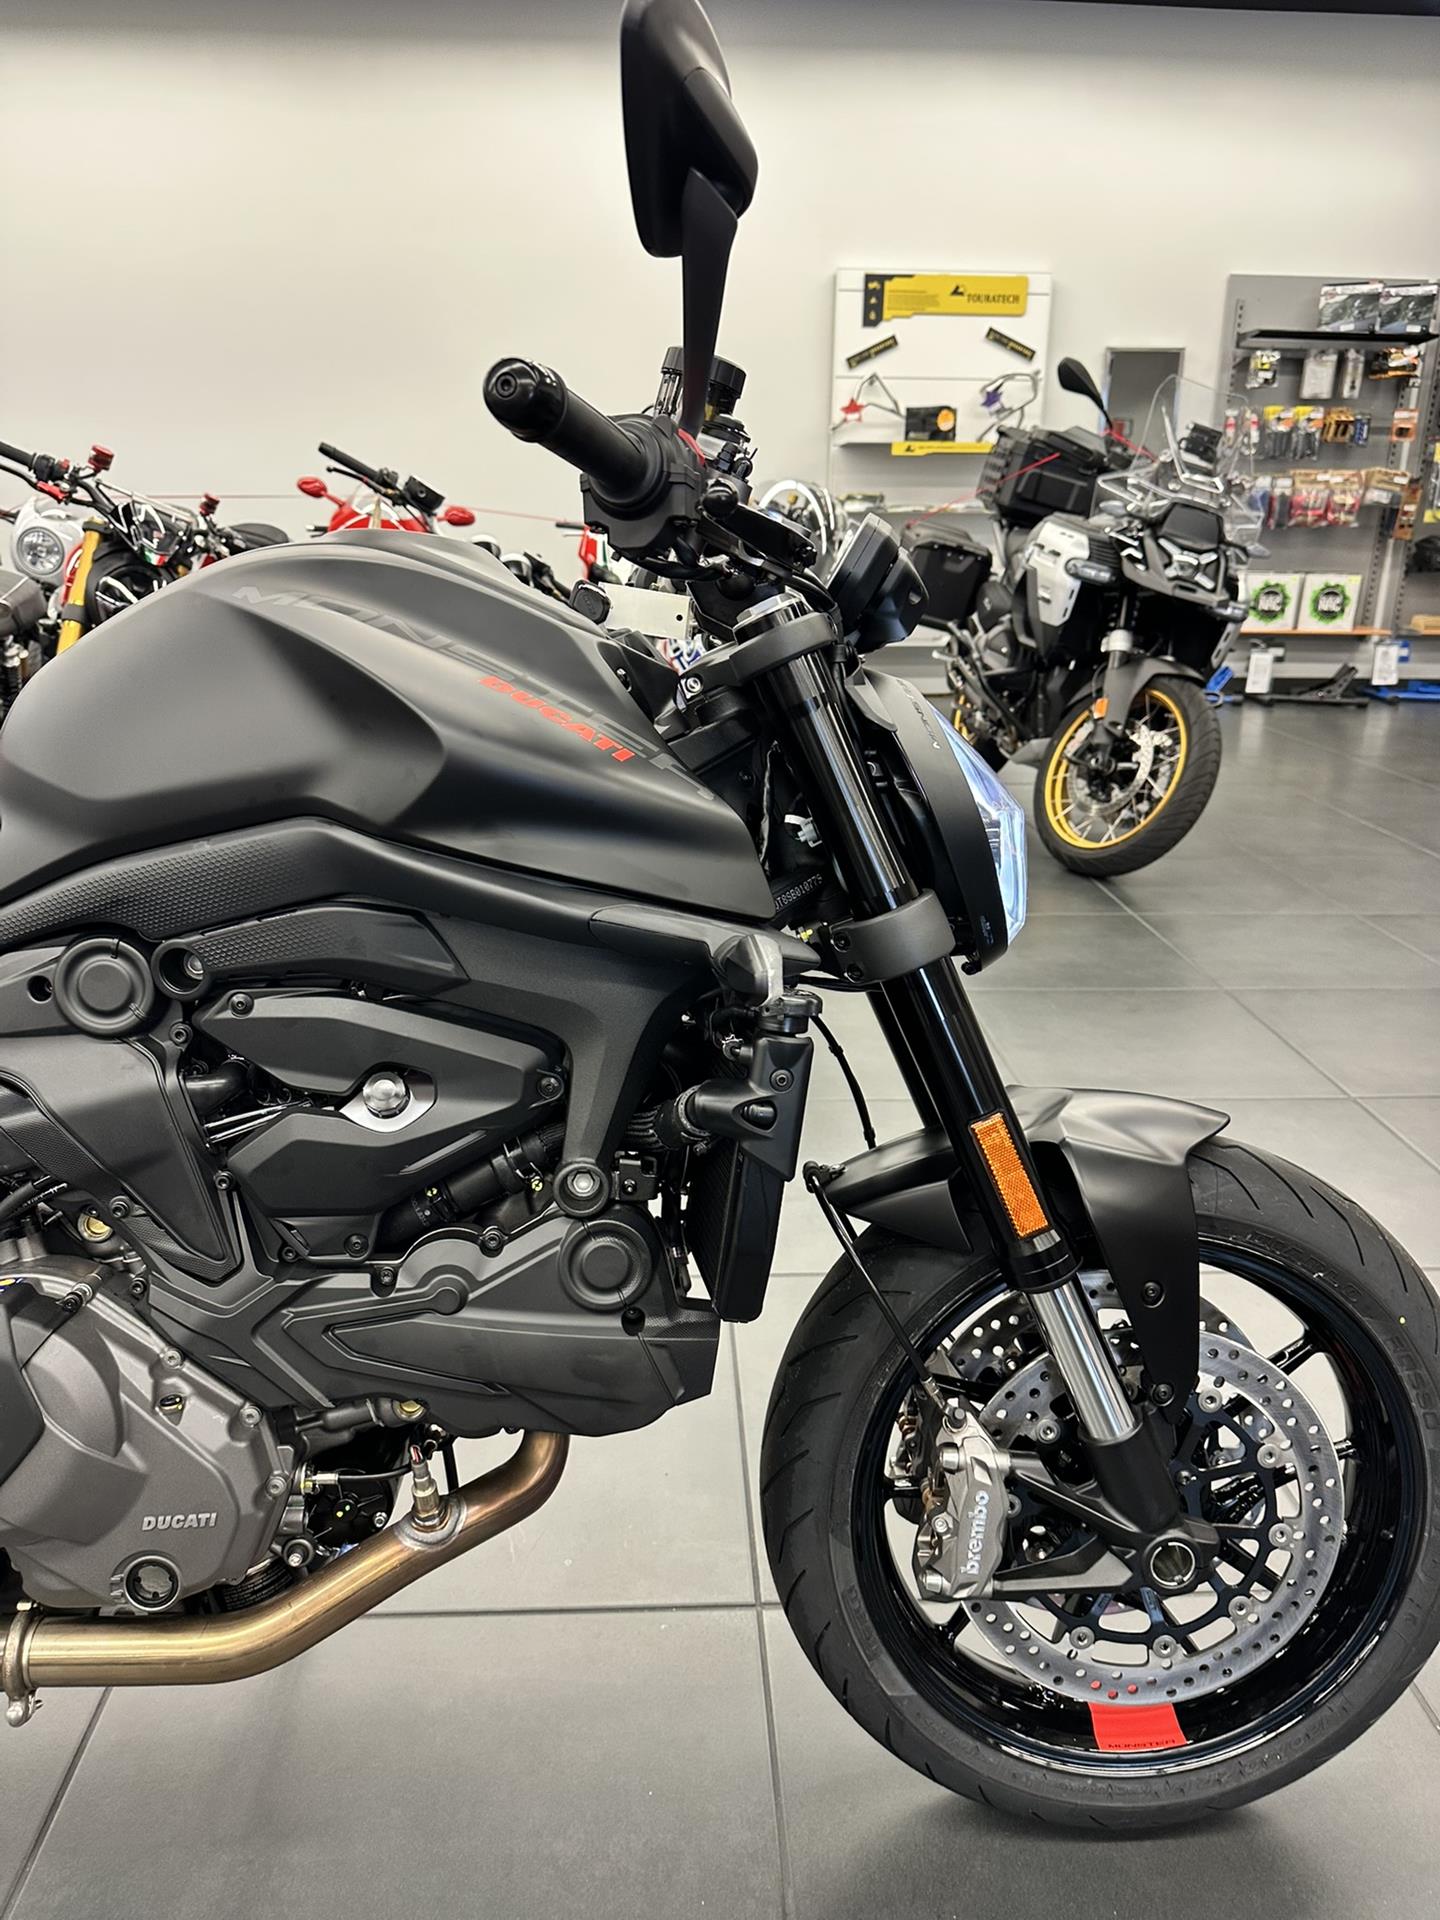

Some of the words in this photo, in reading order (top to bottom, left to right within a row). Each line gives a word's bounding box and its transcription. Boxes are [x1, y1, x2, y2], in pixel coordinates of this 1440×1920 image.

[967, 293, 1020, 305] TOURATECH
[478, 675, 636, 763] DUCATI
[142, 1512, 217, 1532] DUCATI
[960, 1490, 989, 1575] brembo
